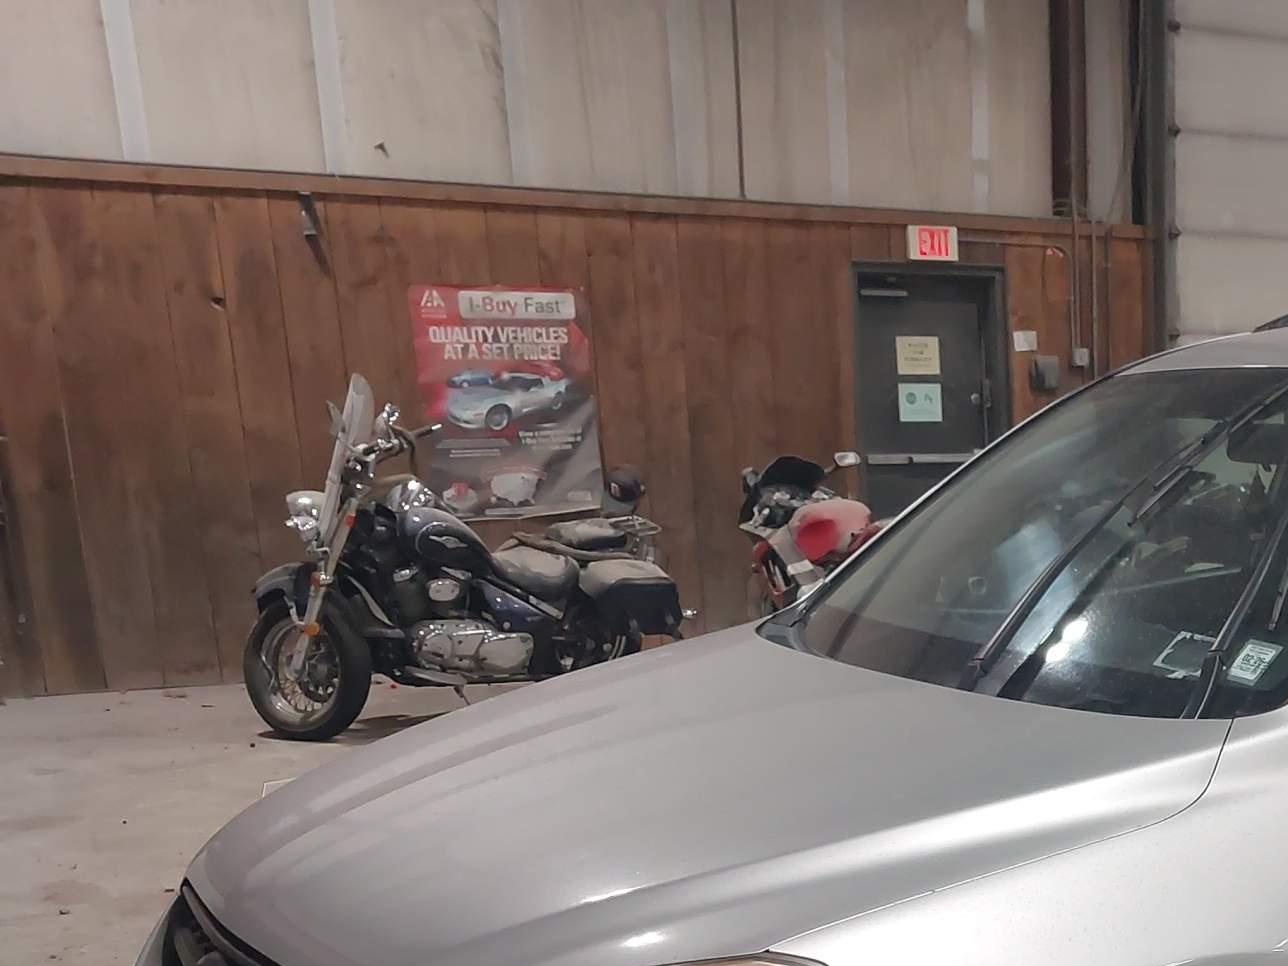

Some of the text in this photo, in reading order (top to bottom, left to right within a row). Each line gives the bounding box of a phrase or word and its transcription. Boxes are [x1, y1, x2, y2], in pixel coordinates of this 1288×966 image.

[918, 227, 950, 257] EXIT
[469, 296, 518, 316] I-Buy
[523, 296, 562, 314] Fast
[428, 325, 569, 344] QUALITY VEHICLES
[443, 343, 561, 361] AT A SET PRICE!
